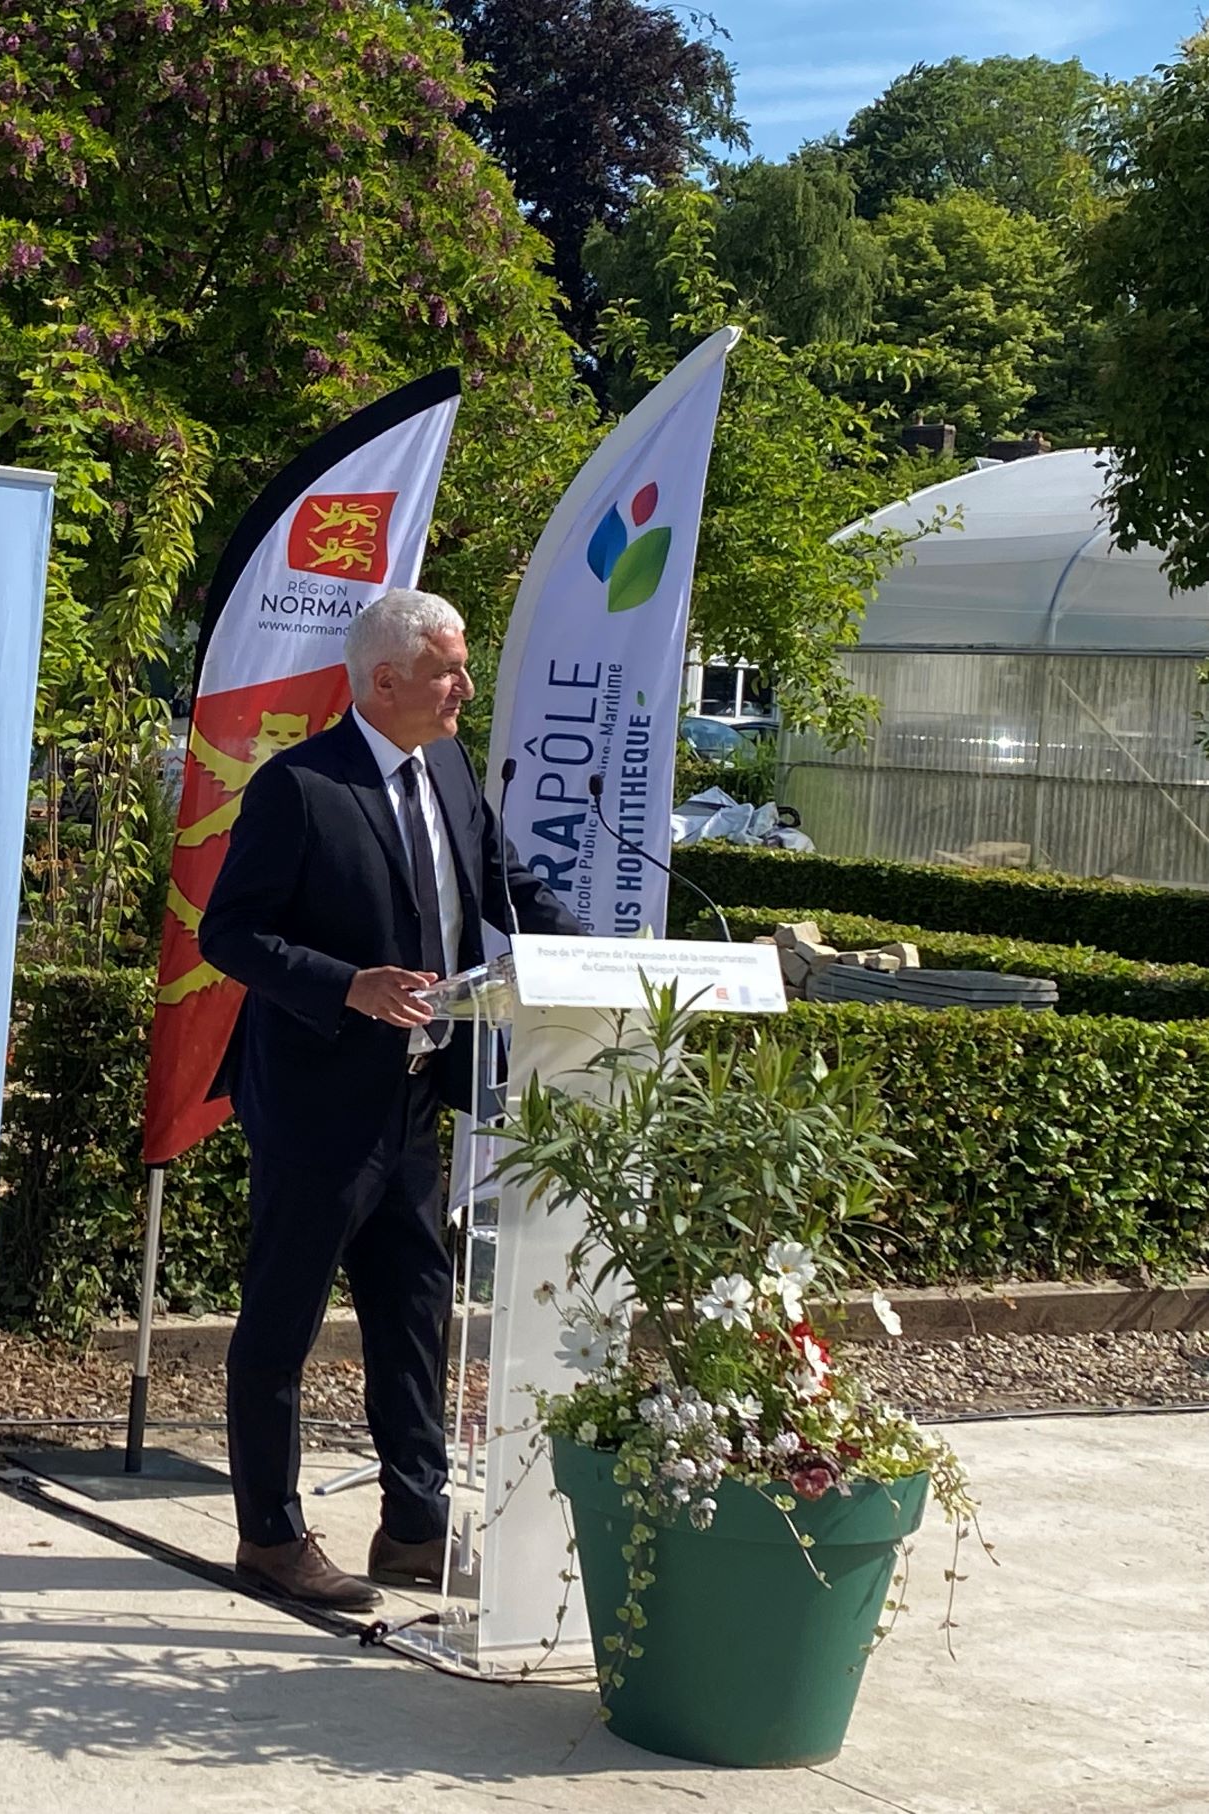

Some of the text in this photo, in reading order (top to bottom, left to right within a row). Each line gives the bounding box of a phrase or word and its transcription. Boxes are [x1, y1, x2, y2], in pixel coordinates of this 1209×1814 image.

[260, 593, 371, 618] NORMAN
[287, 580, 348, 597] RÉGION
[258, 620, 350, 637] www.normand
[523, 659, 602, 893] RAPÔLE
[579, 818, 599, 869] Public
[573, 874, 595, 932] gricole
[614, 901, 641, 937] US
